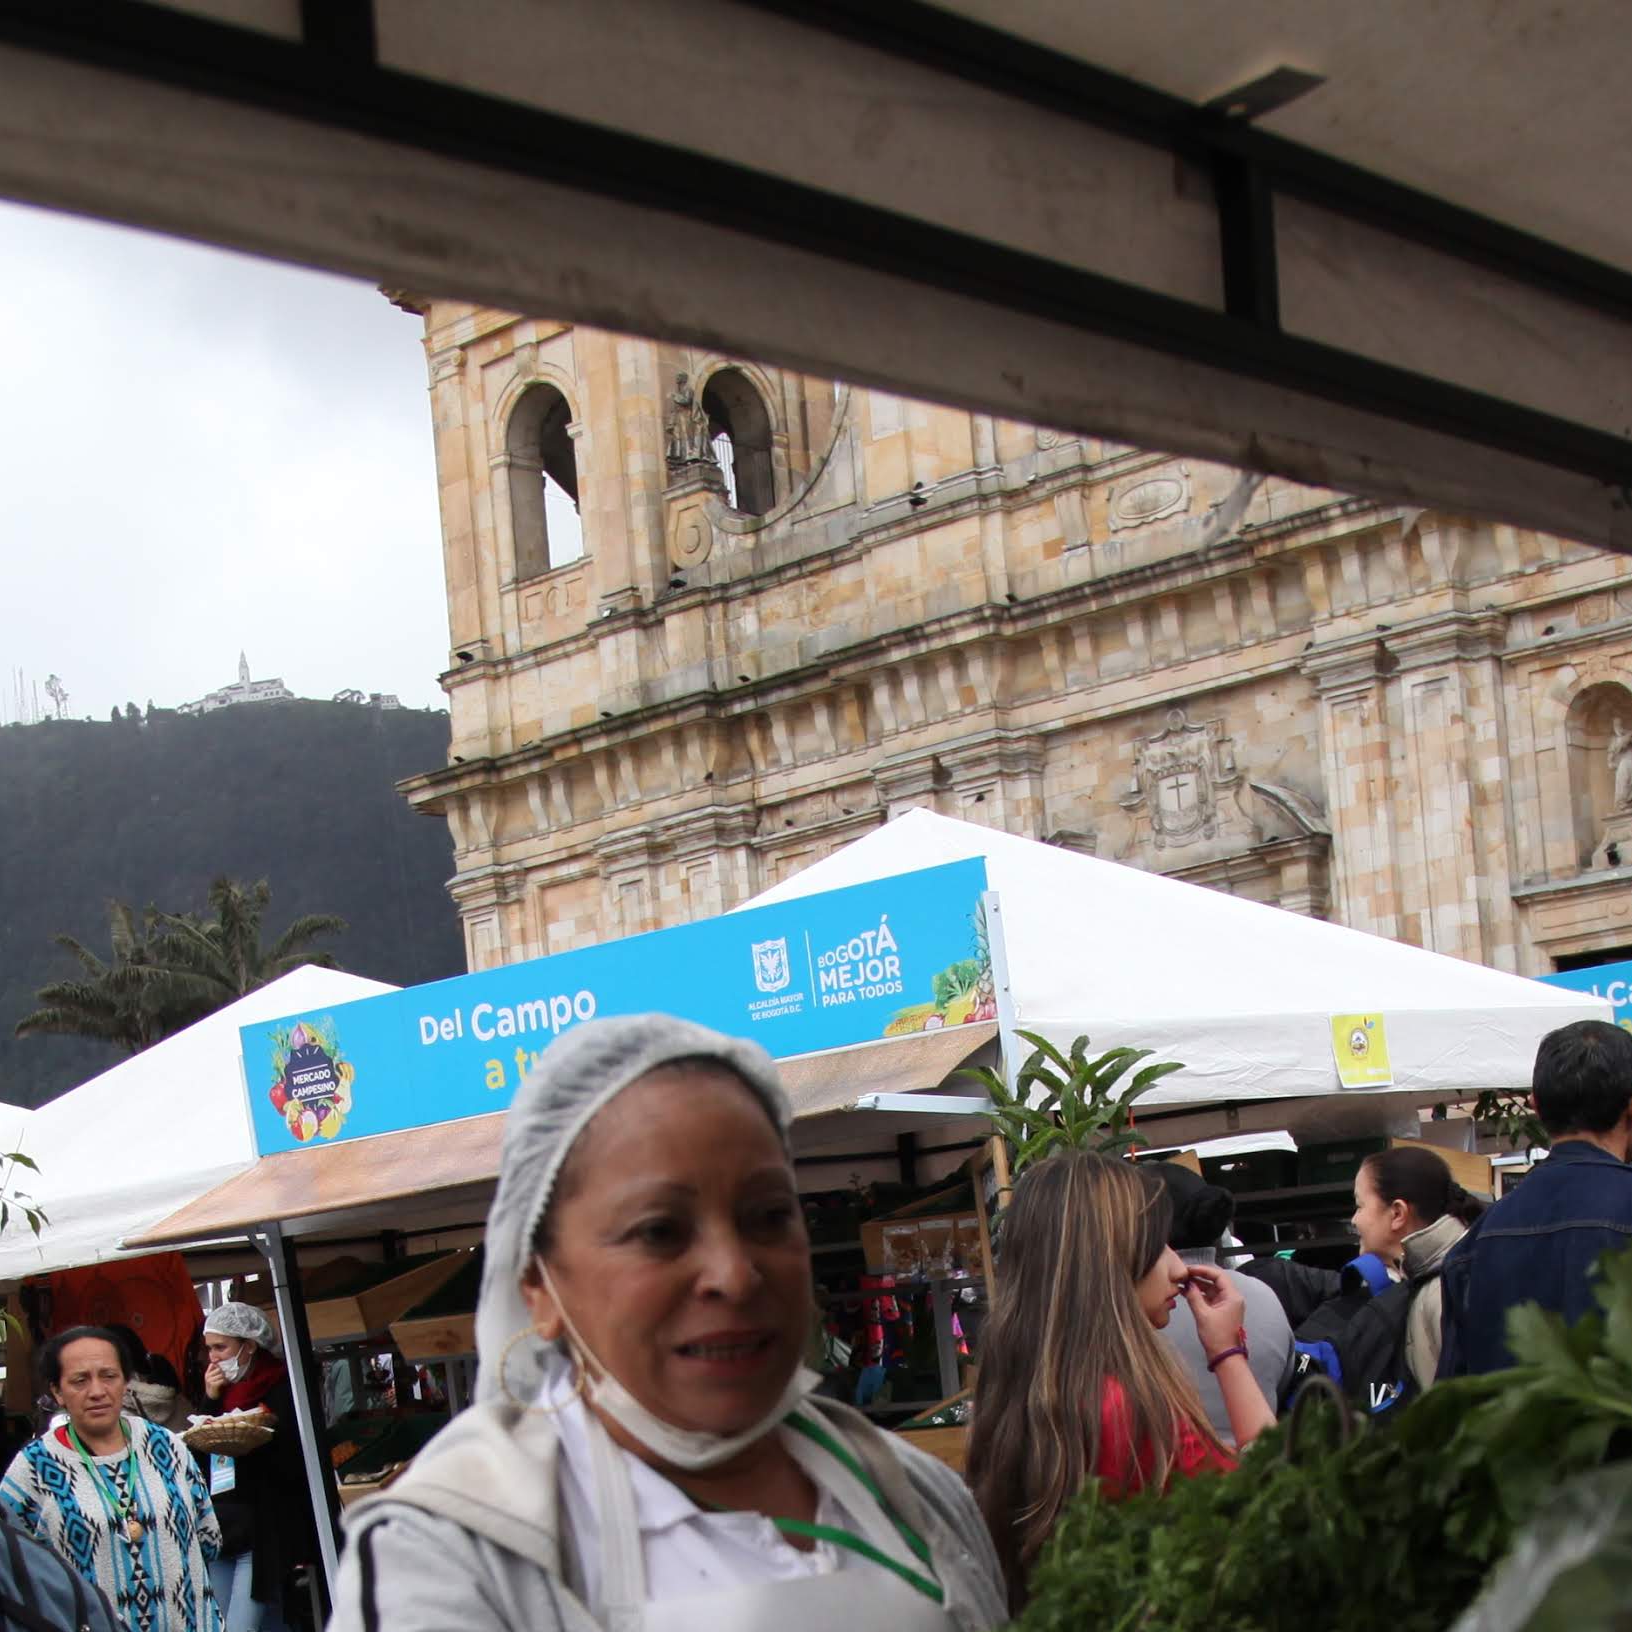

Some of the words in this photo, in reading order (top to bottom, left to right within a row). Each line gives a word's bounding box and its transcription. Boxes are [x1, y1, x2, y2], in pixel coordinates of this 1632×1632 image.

[817, 914, 898, 968] BOGOTÁ
[819, 955, 901, 992] MEJOR
[822, 990, 857, 1008] PARA
[858, 980, 903, 1000] TODOS
[419, 1008, 463, 1045] Del
[471, 990, 596, 1041] Campo
[293, 1069, 331, 1086] MERCADO
[485, 1058, 506, 1089] a
[514, 1047, 541, 1083] t
[292, 1081, 336, 1099] CAMPESINO
